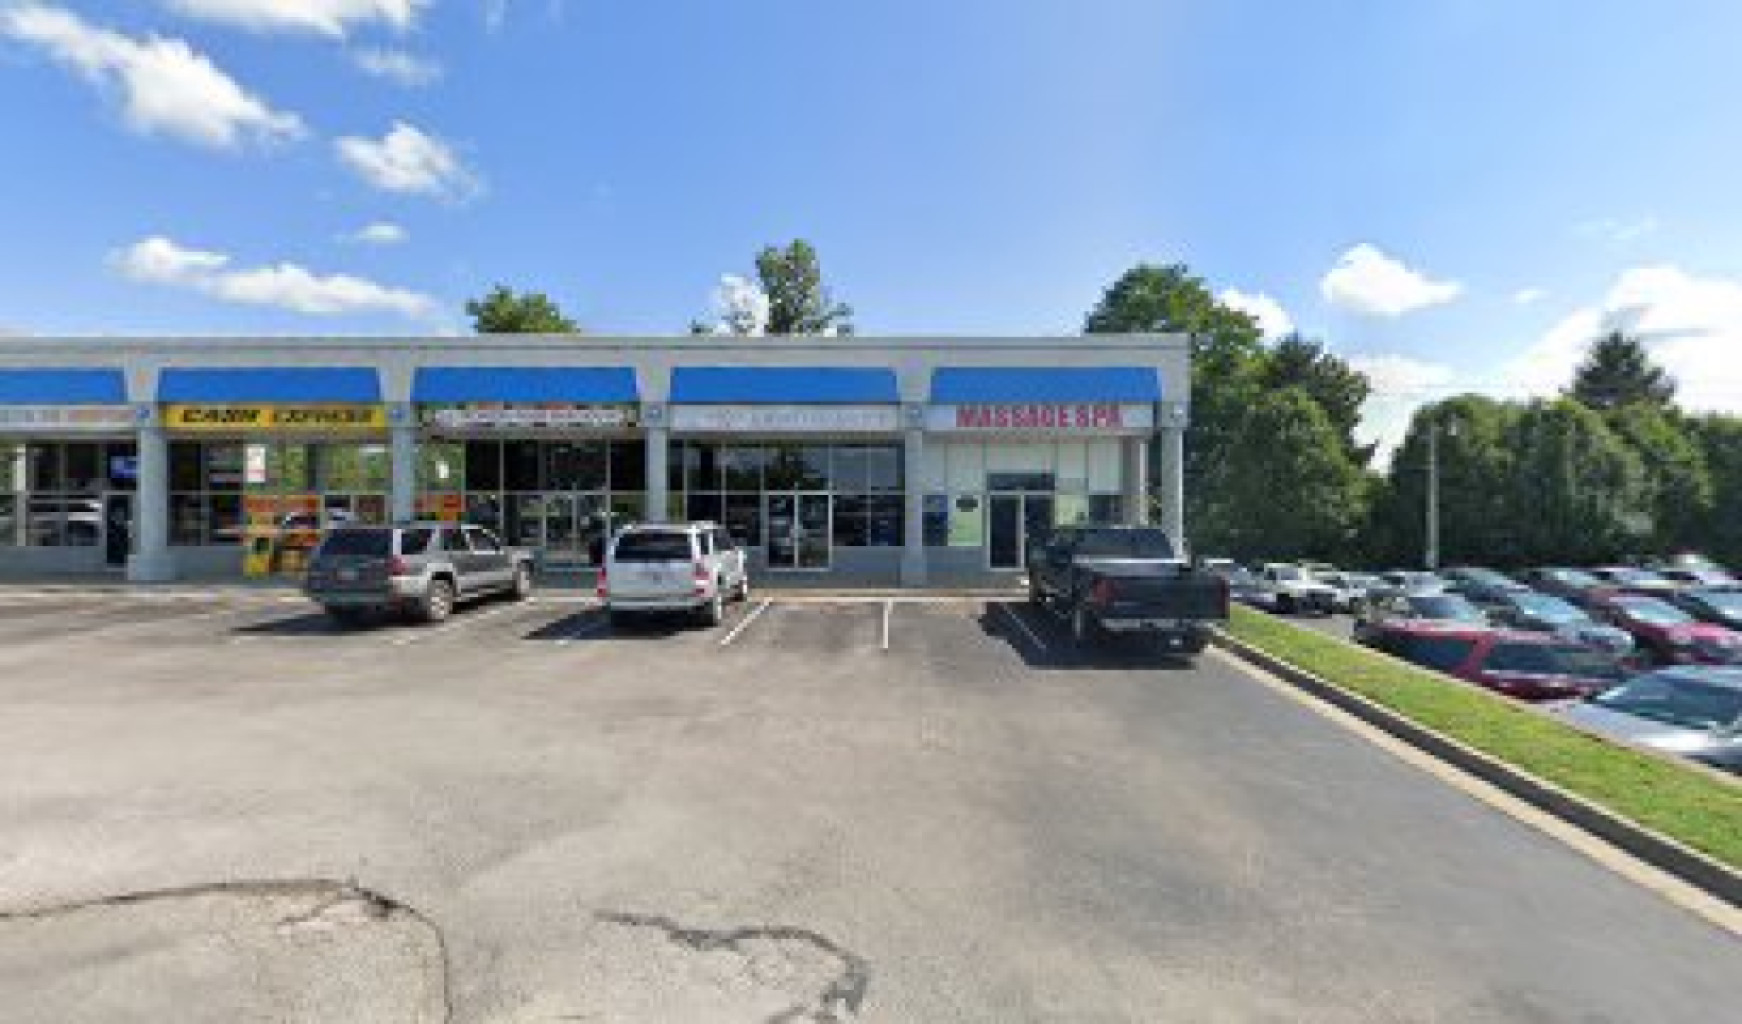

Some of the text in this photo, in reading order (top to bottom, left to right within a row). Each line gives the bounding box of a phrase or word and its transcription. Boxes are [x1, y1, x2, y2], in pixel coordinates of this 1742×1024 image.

[181, 408, 375, 424] CASH EXPRESS
[957, 405, 1123, 428] MASSAGE SPA
